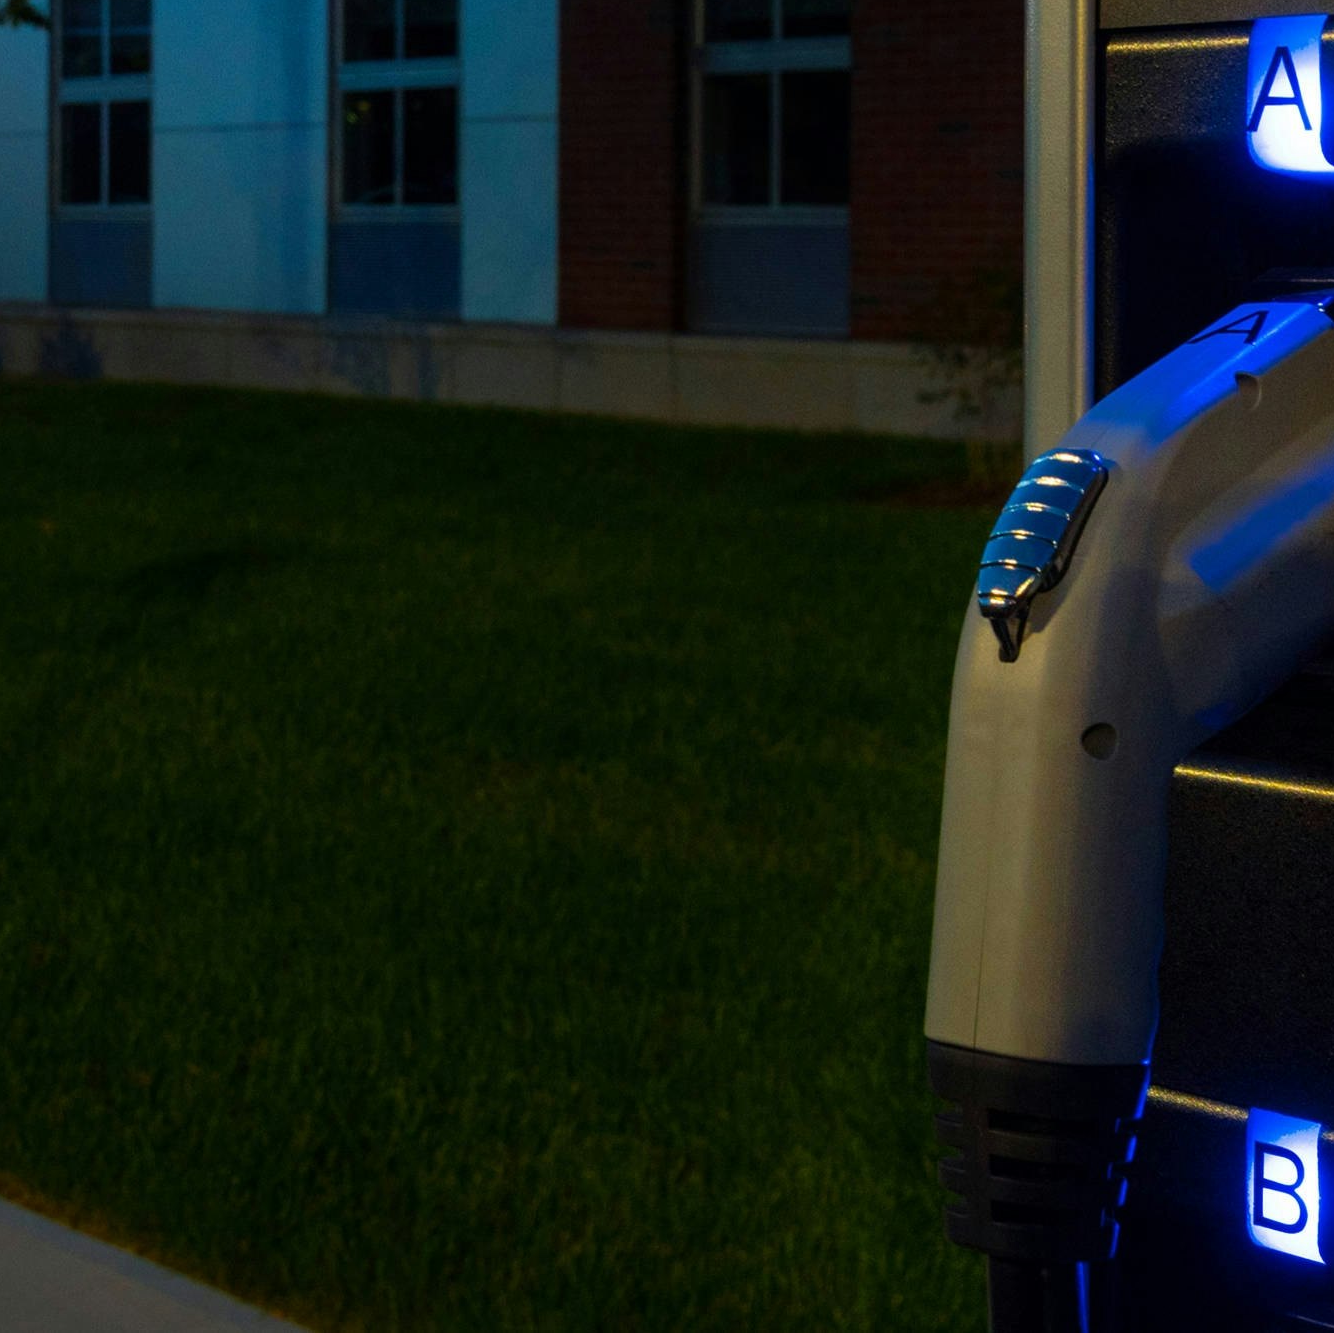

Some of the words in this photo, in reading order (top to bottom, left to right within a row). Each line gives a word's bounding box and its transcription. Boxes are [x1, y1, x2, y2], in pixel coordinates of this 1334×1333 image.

[1246, 46, 1312, 132] A
[1187, 310, 1270, 345] A
[1253, 1140, 1308, 1234] B
